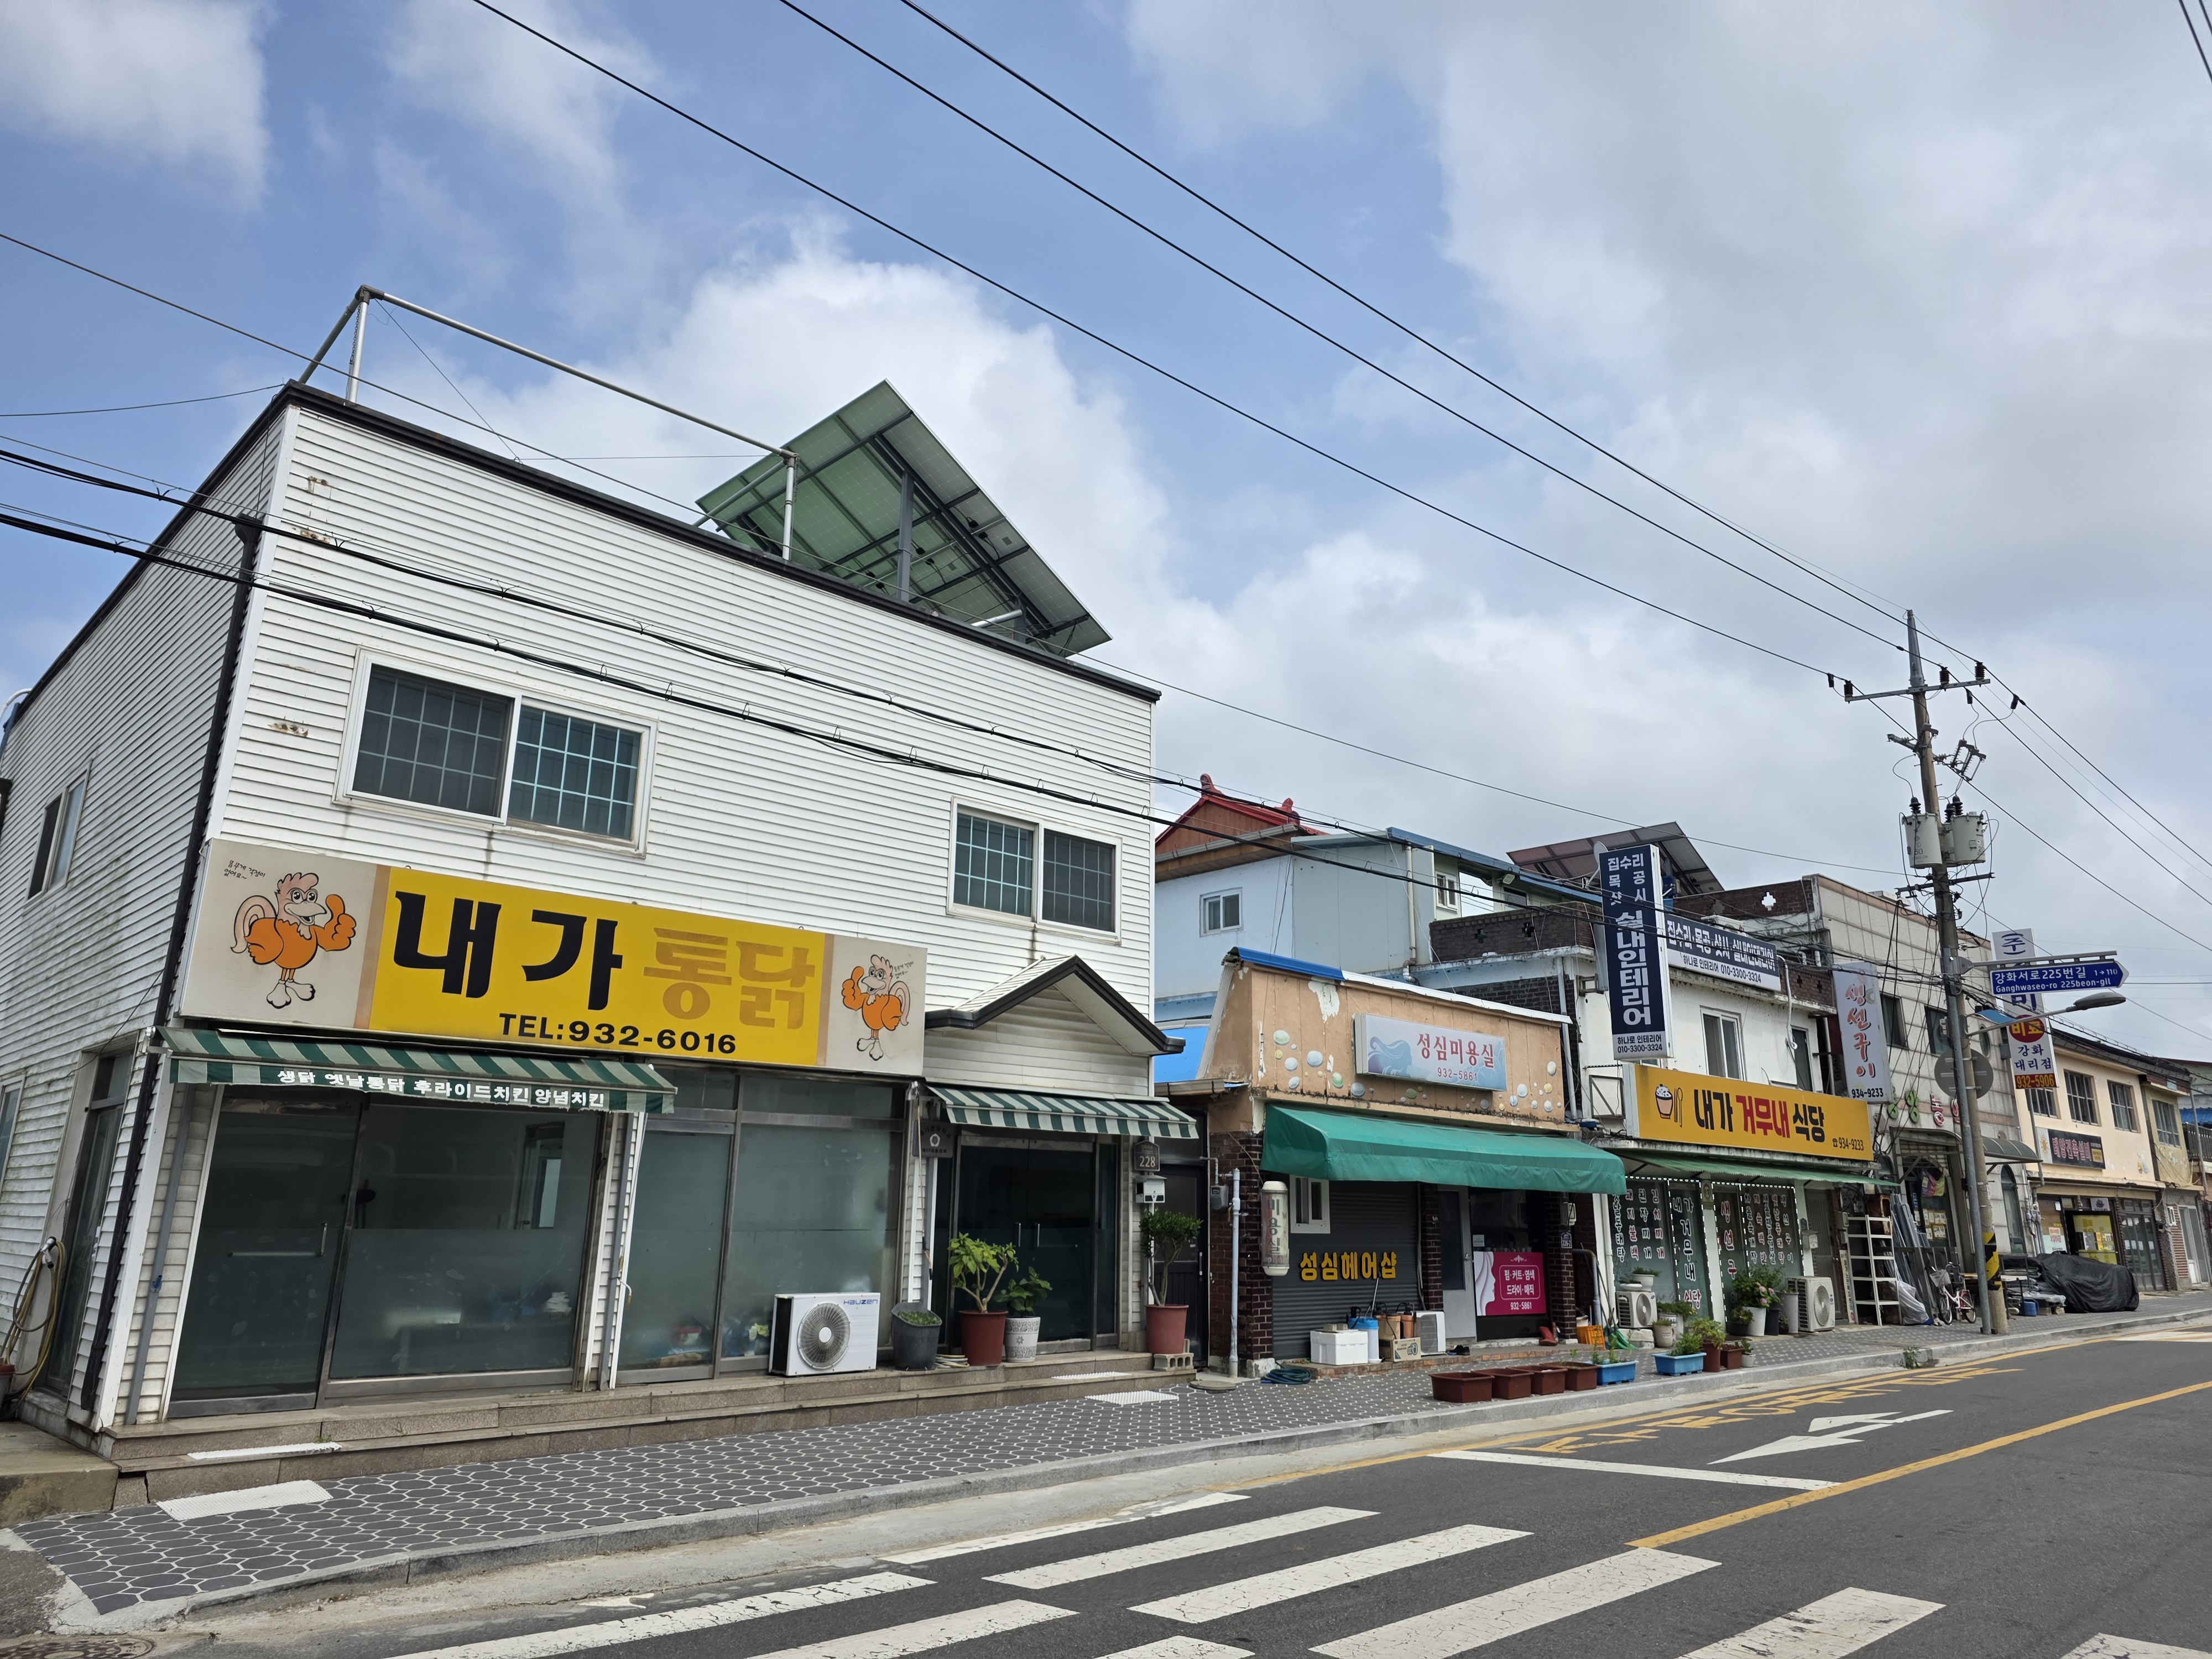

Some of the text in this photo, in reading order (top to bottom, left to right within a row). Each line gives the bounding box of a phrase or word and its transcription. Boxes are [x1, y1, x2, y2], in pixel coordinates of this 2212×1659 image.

[1608, 853, 1644, 872] 집수리
[393, 890, 816, 1030] 내가 통닭
[1615, 910, 1651, 1026] 실내인테리어
[1683, 955, 1762, 984] 하나로 인테리어 010-3300-3324
[1995, 966, 2086, 984] 강화서로225번길
[1995, 978, 2111, 993] Ganghwaseo-ro 225beon-gil
[499, 1012, 737, 1055] TEL:932-6016
[1617, 1034, 1662, 1045] 하나로 인테리어
[1845, 983, 1876, 1079] 생선구이
[2011, 1021, 2044, 1037] 비료
[1417, 1033, 1495, 1068] 성심미용실
[1617, 1042, 1663, 1053] 010-3300-3324
[2018, 1044, 2044, 1057] 강화
[1437, 1067, 1478, 1081] 932-5861
[2014, 1057, 2052, 1071] 대리점
[277, 1069, 606, 1108] 생닭 옛날통닭 후라이드치킨 양념치킨
[2016, 1074, 2054, 1088] 932-5906
[1851, 1087, 1884, 1098] 934-9233
[1694, 1088, 1825, 1143] 내가 거무내 식당
[1838, 1138, 1864, 1152] 934-9233
[1139, 1155, 1156, 1168] 228
[1672, 1196, 1694, 1213] 내가
[1267, 1198, 1281, 1254] 미용실
[1638, 1188, 1652, 1260] 된장찌개
[1651, 1188, 1665, 1259] 김치찌개
[1780, 1193, 1794, 1264] 생선구이
[1679, 1218, 1696, 1282] 거무내
[1300, 1250, 1398, 1282] 성심헤어샵
[1683, 1288, 1702, 1310] 식당
